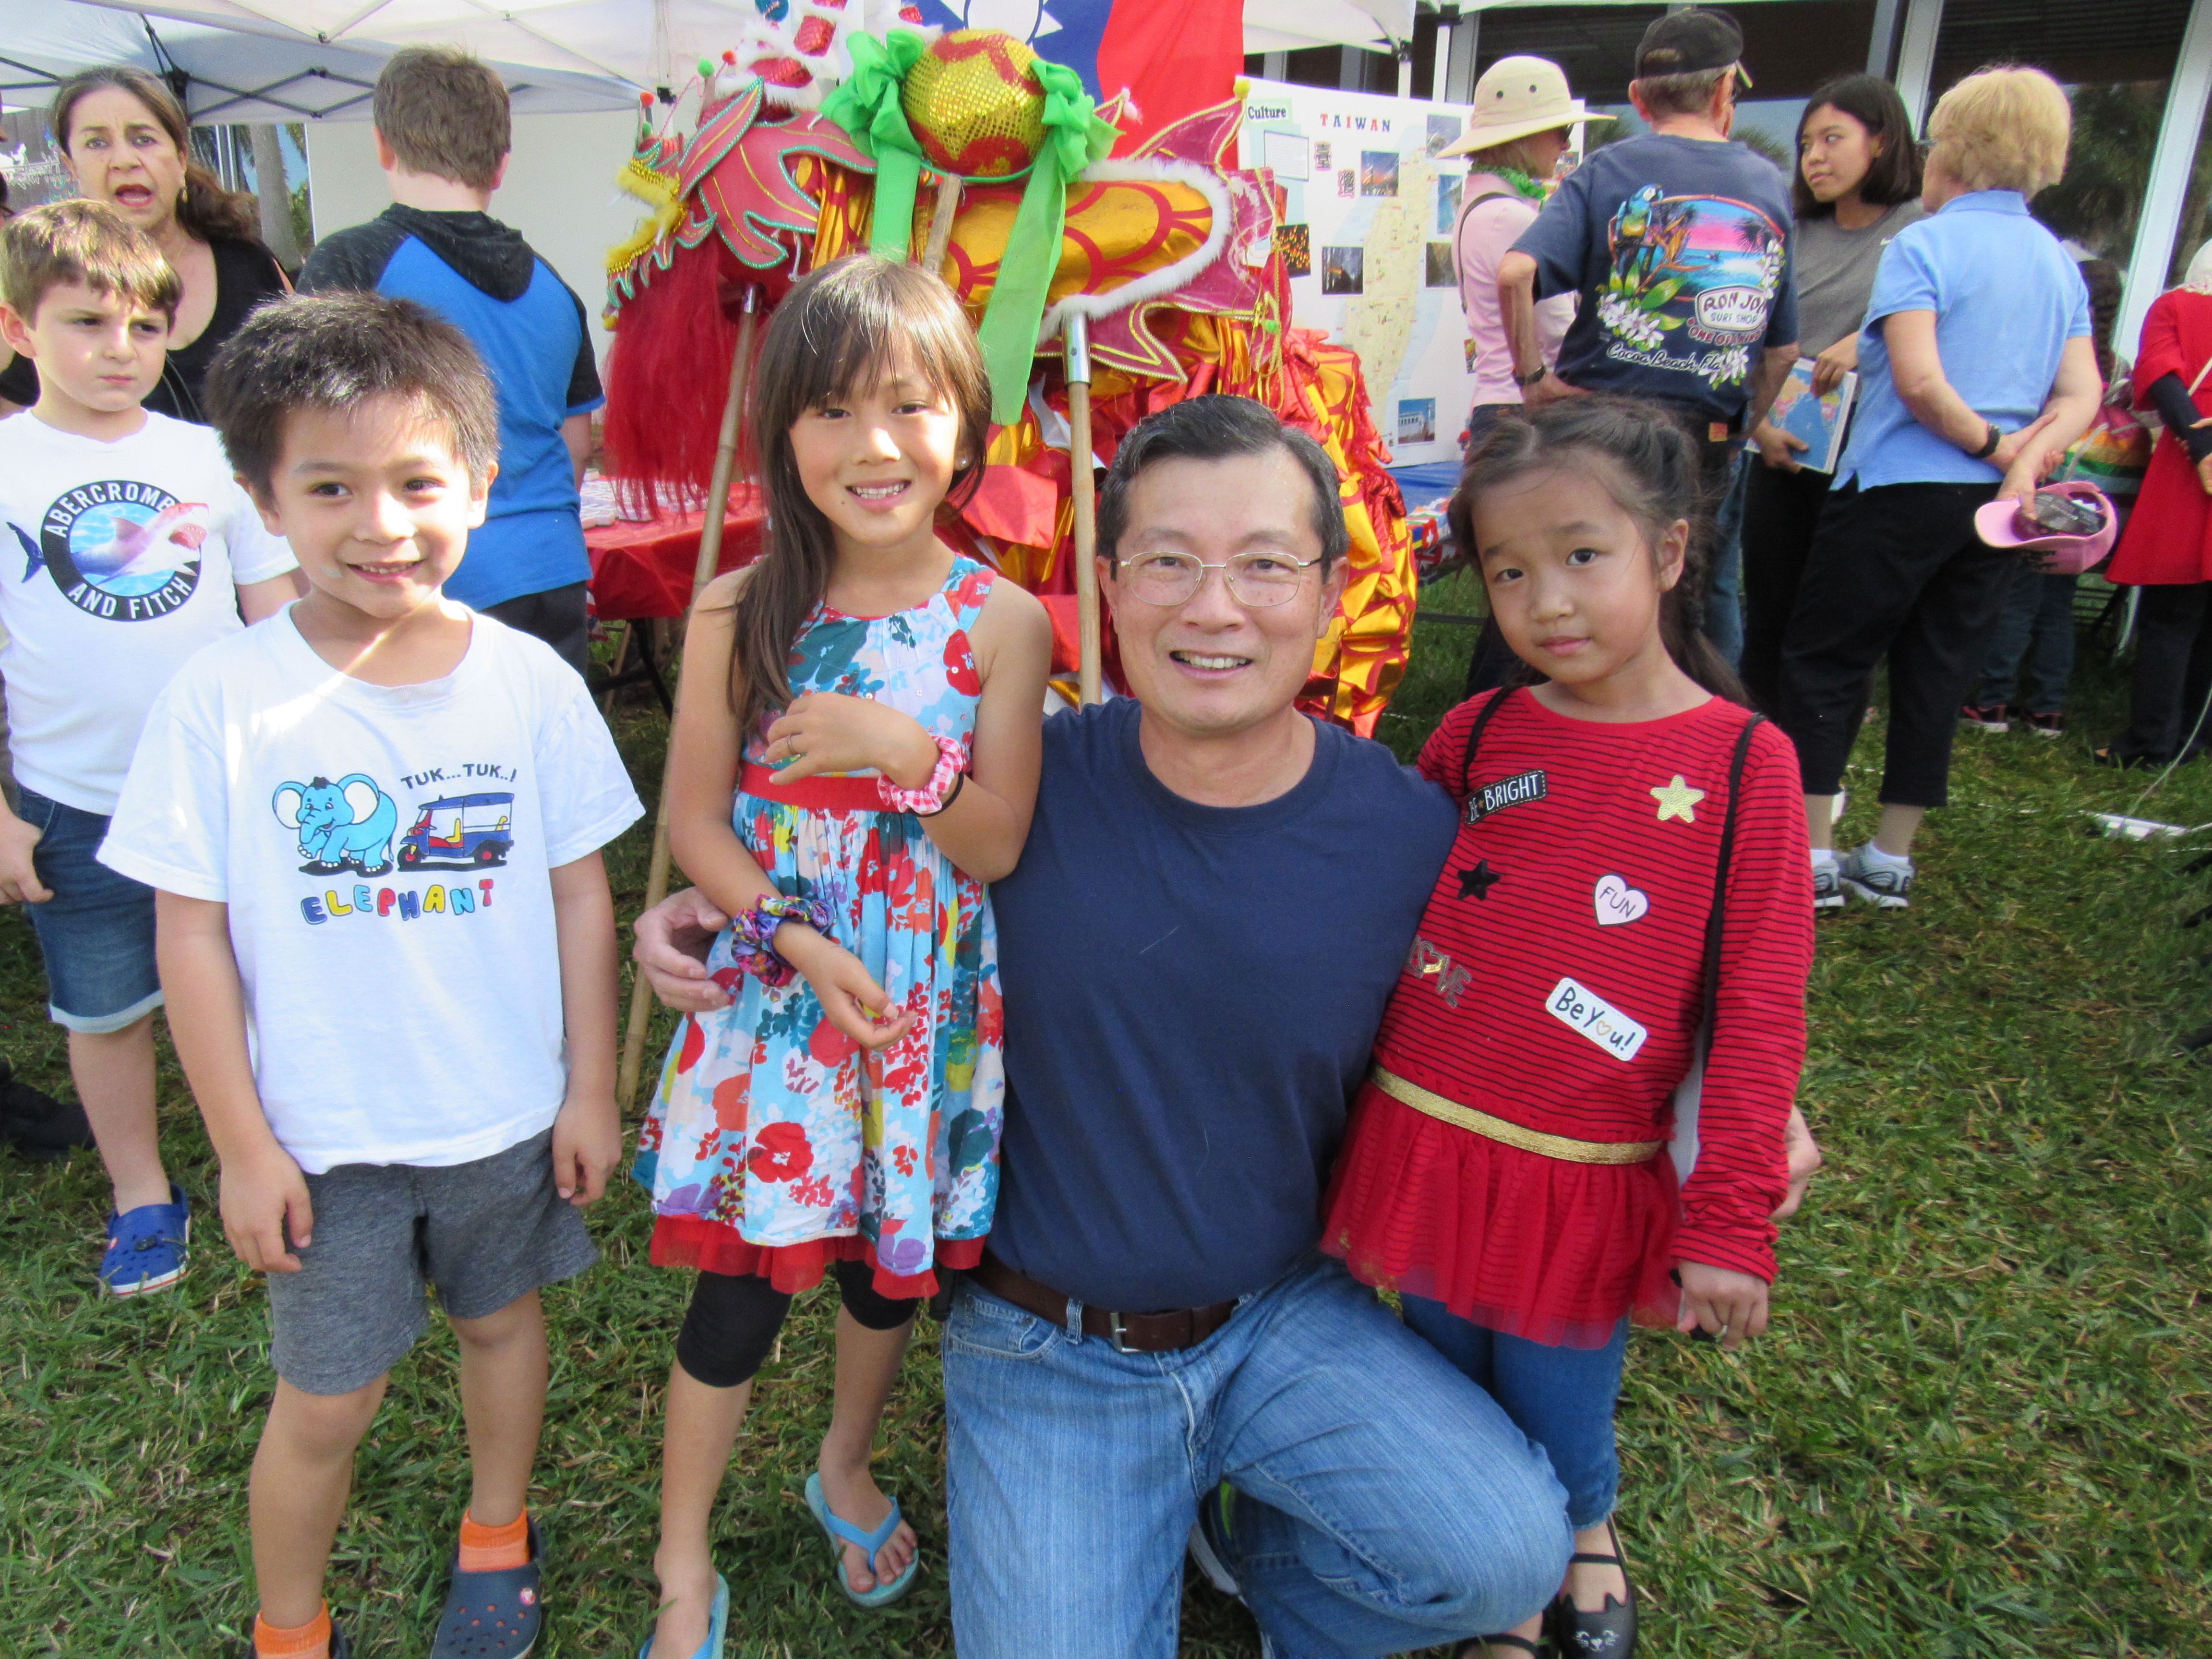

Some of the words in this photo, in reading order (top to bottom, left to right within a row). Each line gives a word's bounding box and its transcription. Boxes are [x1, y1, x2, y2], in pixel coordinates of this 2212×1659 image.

[1248, 106, 1287, 120] Culture
[1320, 113, 1391, 132] TAIWAN
[1704, 292, 1739, 312] RON
[1740, 294, 1766, 314] JON
[1710, 312, 1734, 323] SURF
[1736, 313, 1758, 325] SHOP
[1688, 325, 1715, 343] ONE
[1607, 340, 1650, 365] Cocoa
[68, 583, 117, 617] AND
[129, 576, 192, 619] FITCH
[1484, 774, 1538, 811] BRIGHT
[301, 878, 494, 925] ELEPHANT
[1599, 886, 1636, 918] FUN
